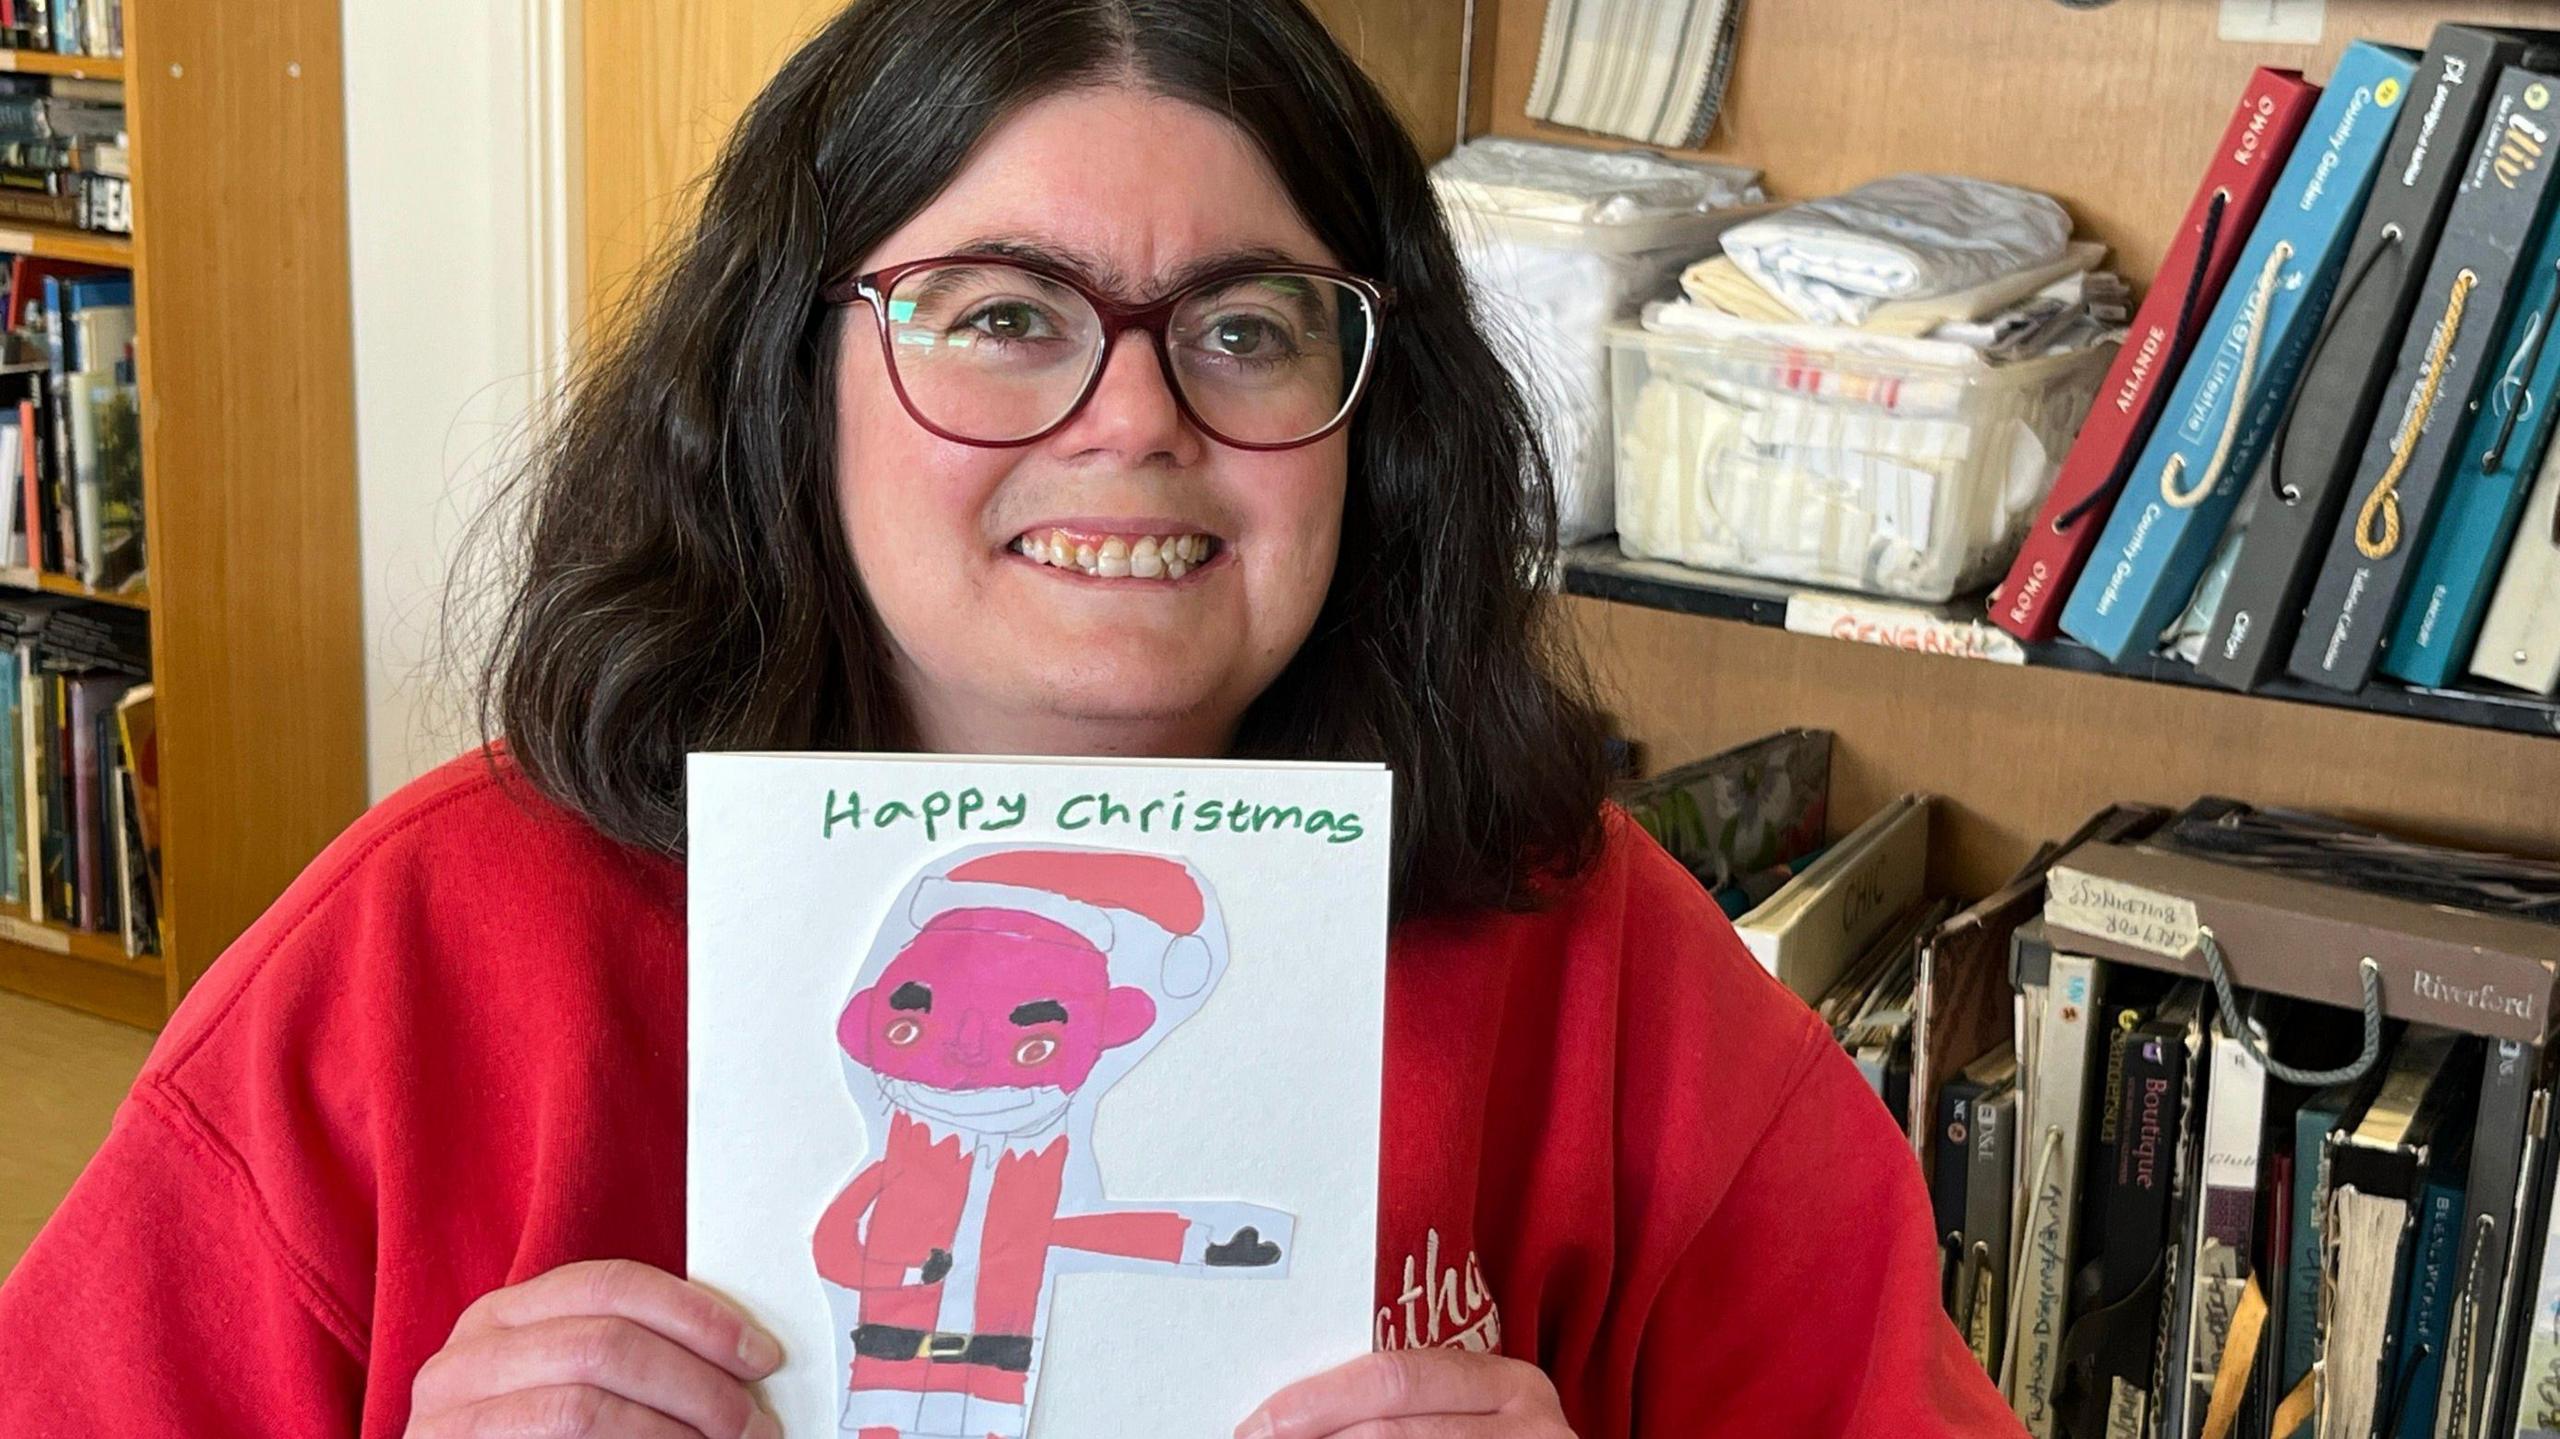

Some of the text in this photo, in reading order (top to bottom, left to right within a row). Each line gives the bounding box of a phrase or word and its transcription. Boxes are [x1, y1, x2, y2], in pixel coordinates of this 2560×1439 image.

[2234, 95, 2274, 165] ROMO
[2300, 86, 2371, 211] Country Garden
[2116, 325, 2166, 414] ALLANDE
[2188, 361, 2230, 431] Lifestyle
[2010, 561, 2047, 624] ROMO
[2096, 503, 2160, 616] Country Garden
[823, 788, 1027, 842] Happy
[1843, 856, 1886, 932] CHIC
[2105, 915, 2138, 938] FOR
[2413, 970, 2533, 1019] Riverford
[2132, 1078, 2168, 1189] Boutique
